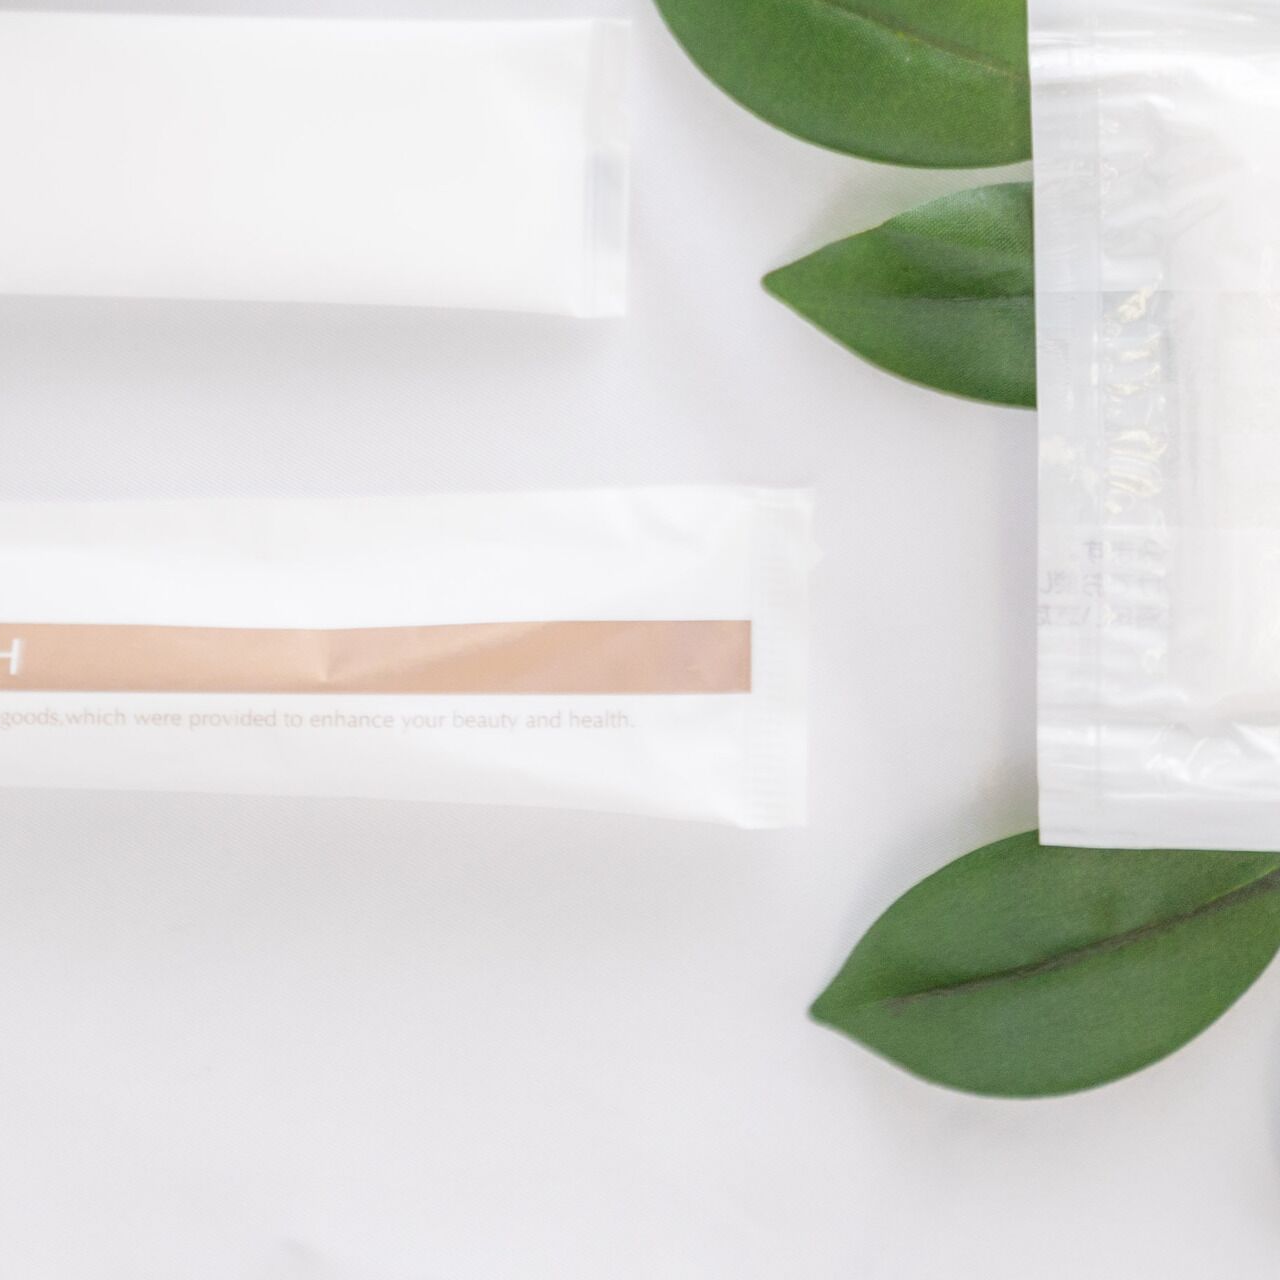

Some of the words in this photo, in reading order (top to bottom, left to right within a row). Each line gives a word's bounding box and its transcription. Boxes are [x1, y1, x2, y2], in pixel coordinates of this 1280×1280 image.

[133, 711, 182, 727] were
[188, 706, 277, 733] provided
[283, 711, 304, 727] to
[310, 708, 395, 729] enhance
[400, 712, 446, 734] your
[452, 708, 519, 733] beauty
[525, 708, 562, 729] and
[568, 708, 636, 729] health.
